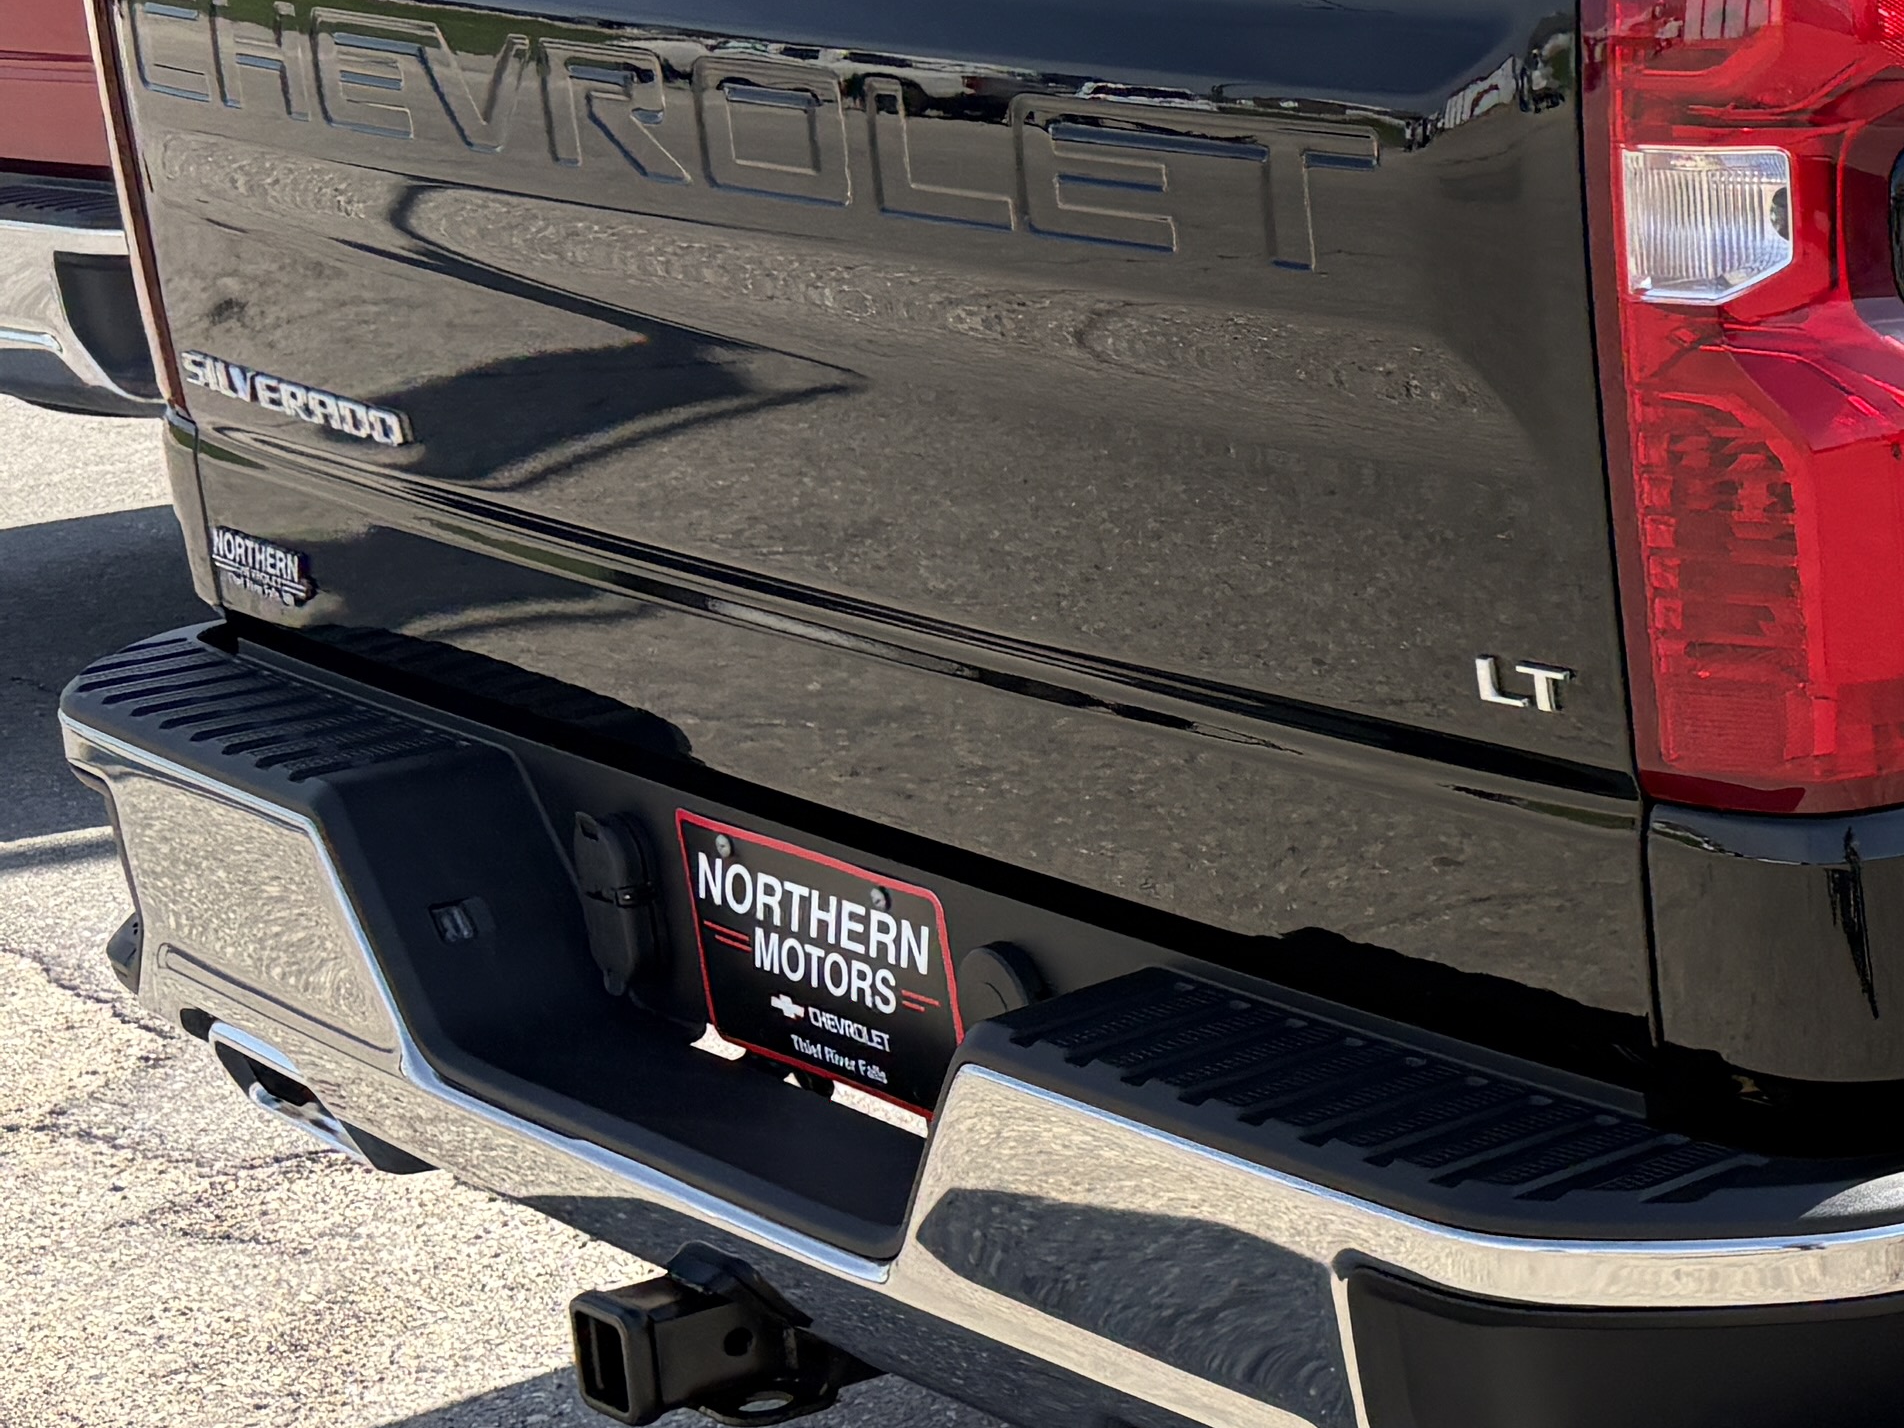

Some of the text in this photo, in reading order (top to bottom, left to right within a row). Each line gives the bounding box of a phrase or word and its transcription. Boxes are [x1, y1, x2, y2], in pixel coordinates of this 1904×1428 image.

[181, 350, 412, 447] SILVERADO
[211, 526, 299, 583] NORTHERN
[1475, 654, 1572, 713] LT
[697, 851, 930, 975] NORTHERN
[754, 926, 897, 1014] MOTORS
[807, 1005, 891, 1053] CHEVROLET
